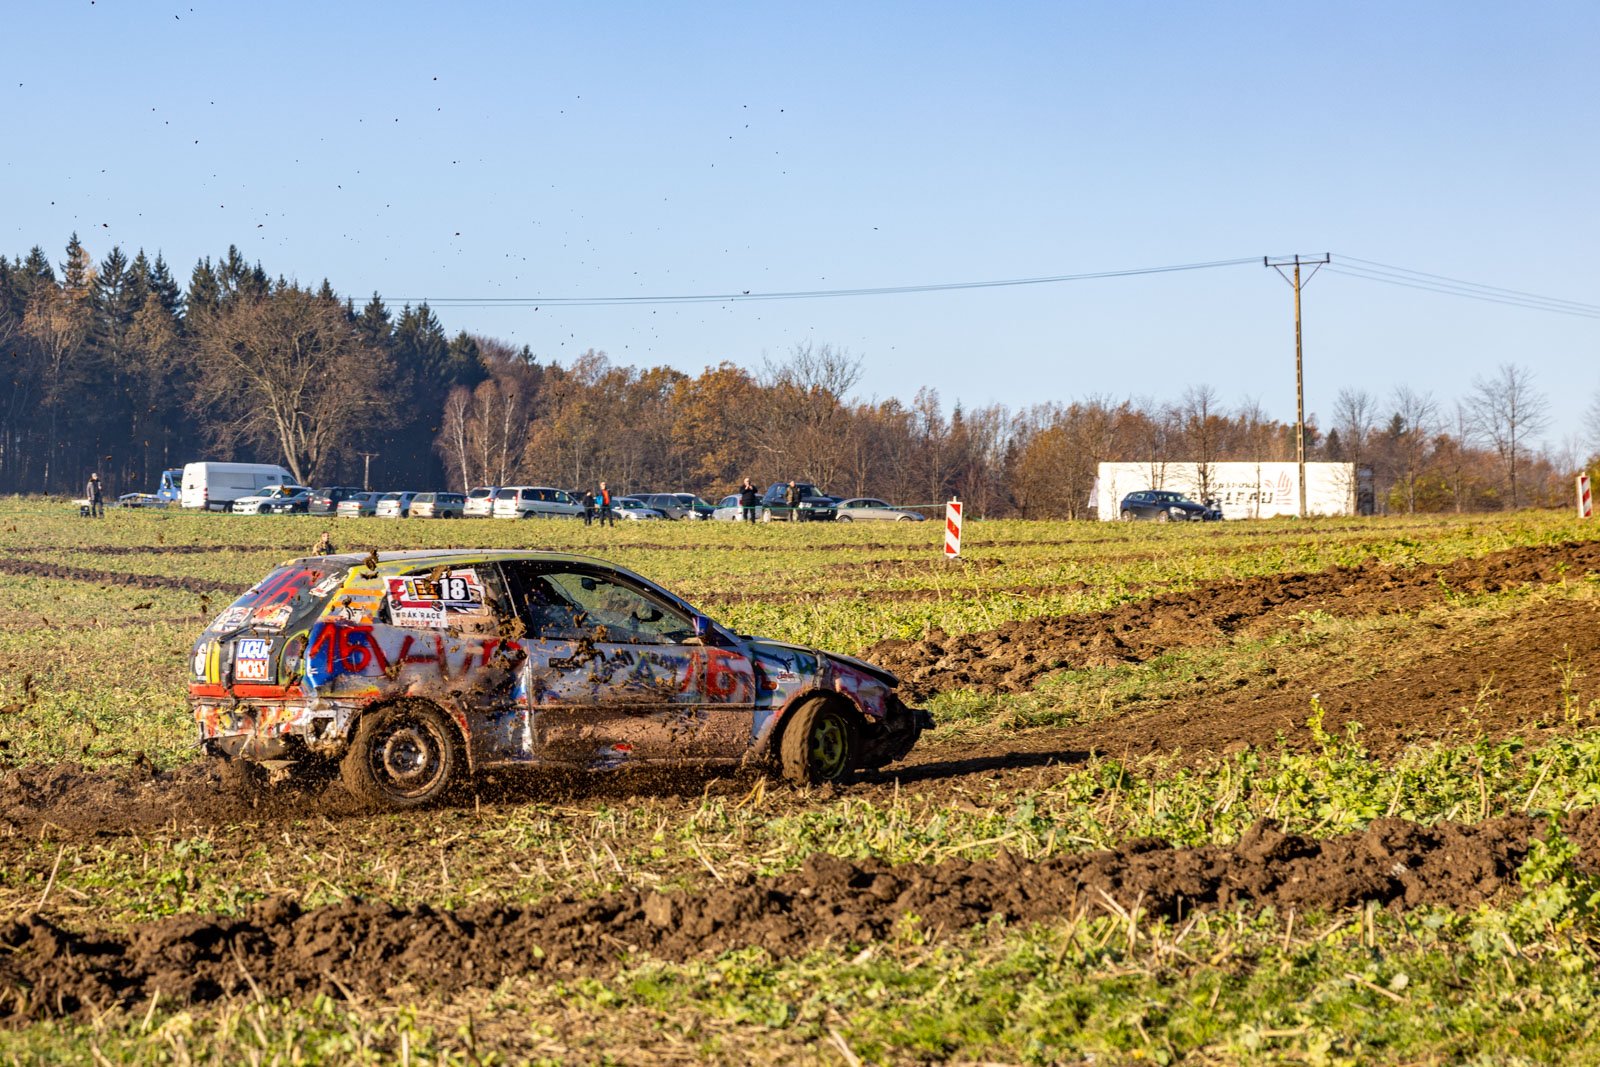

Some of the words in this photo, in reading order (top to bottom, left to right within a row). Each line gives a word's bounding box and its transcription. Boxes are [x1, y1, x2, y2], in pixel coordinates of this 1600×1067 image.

[439, 578, 466, 600] 18
[420, 611, 441, 619] RACE
[238, 660, 267, 678] MOLY
